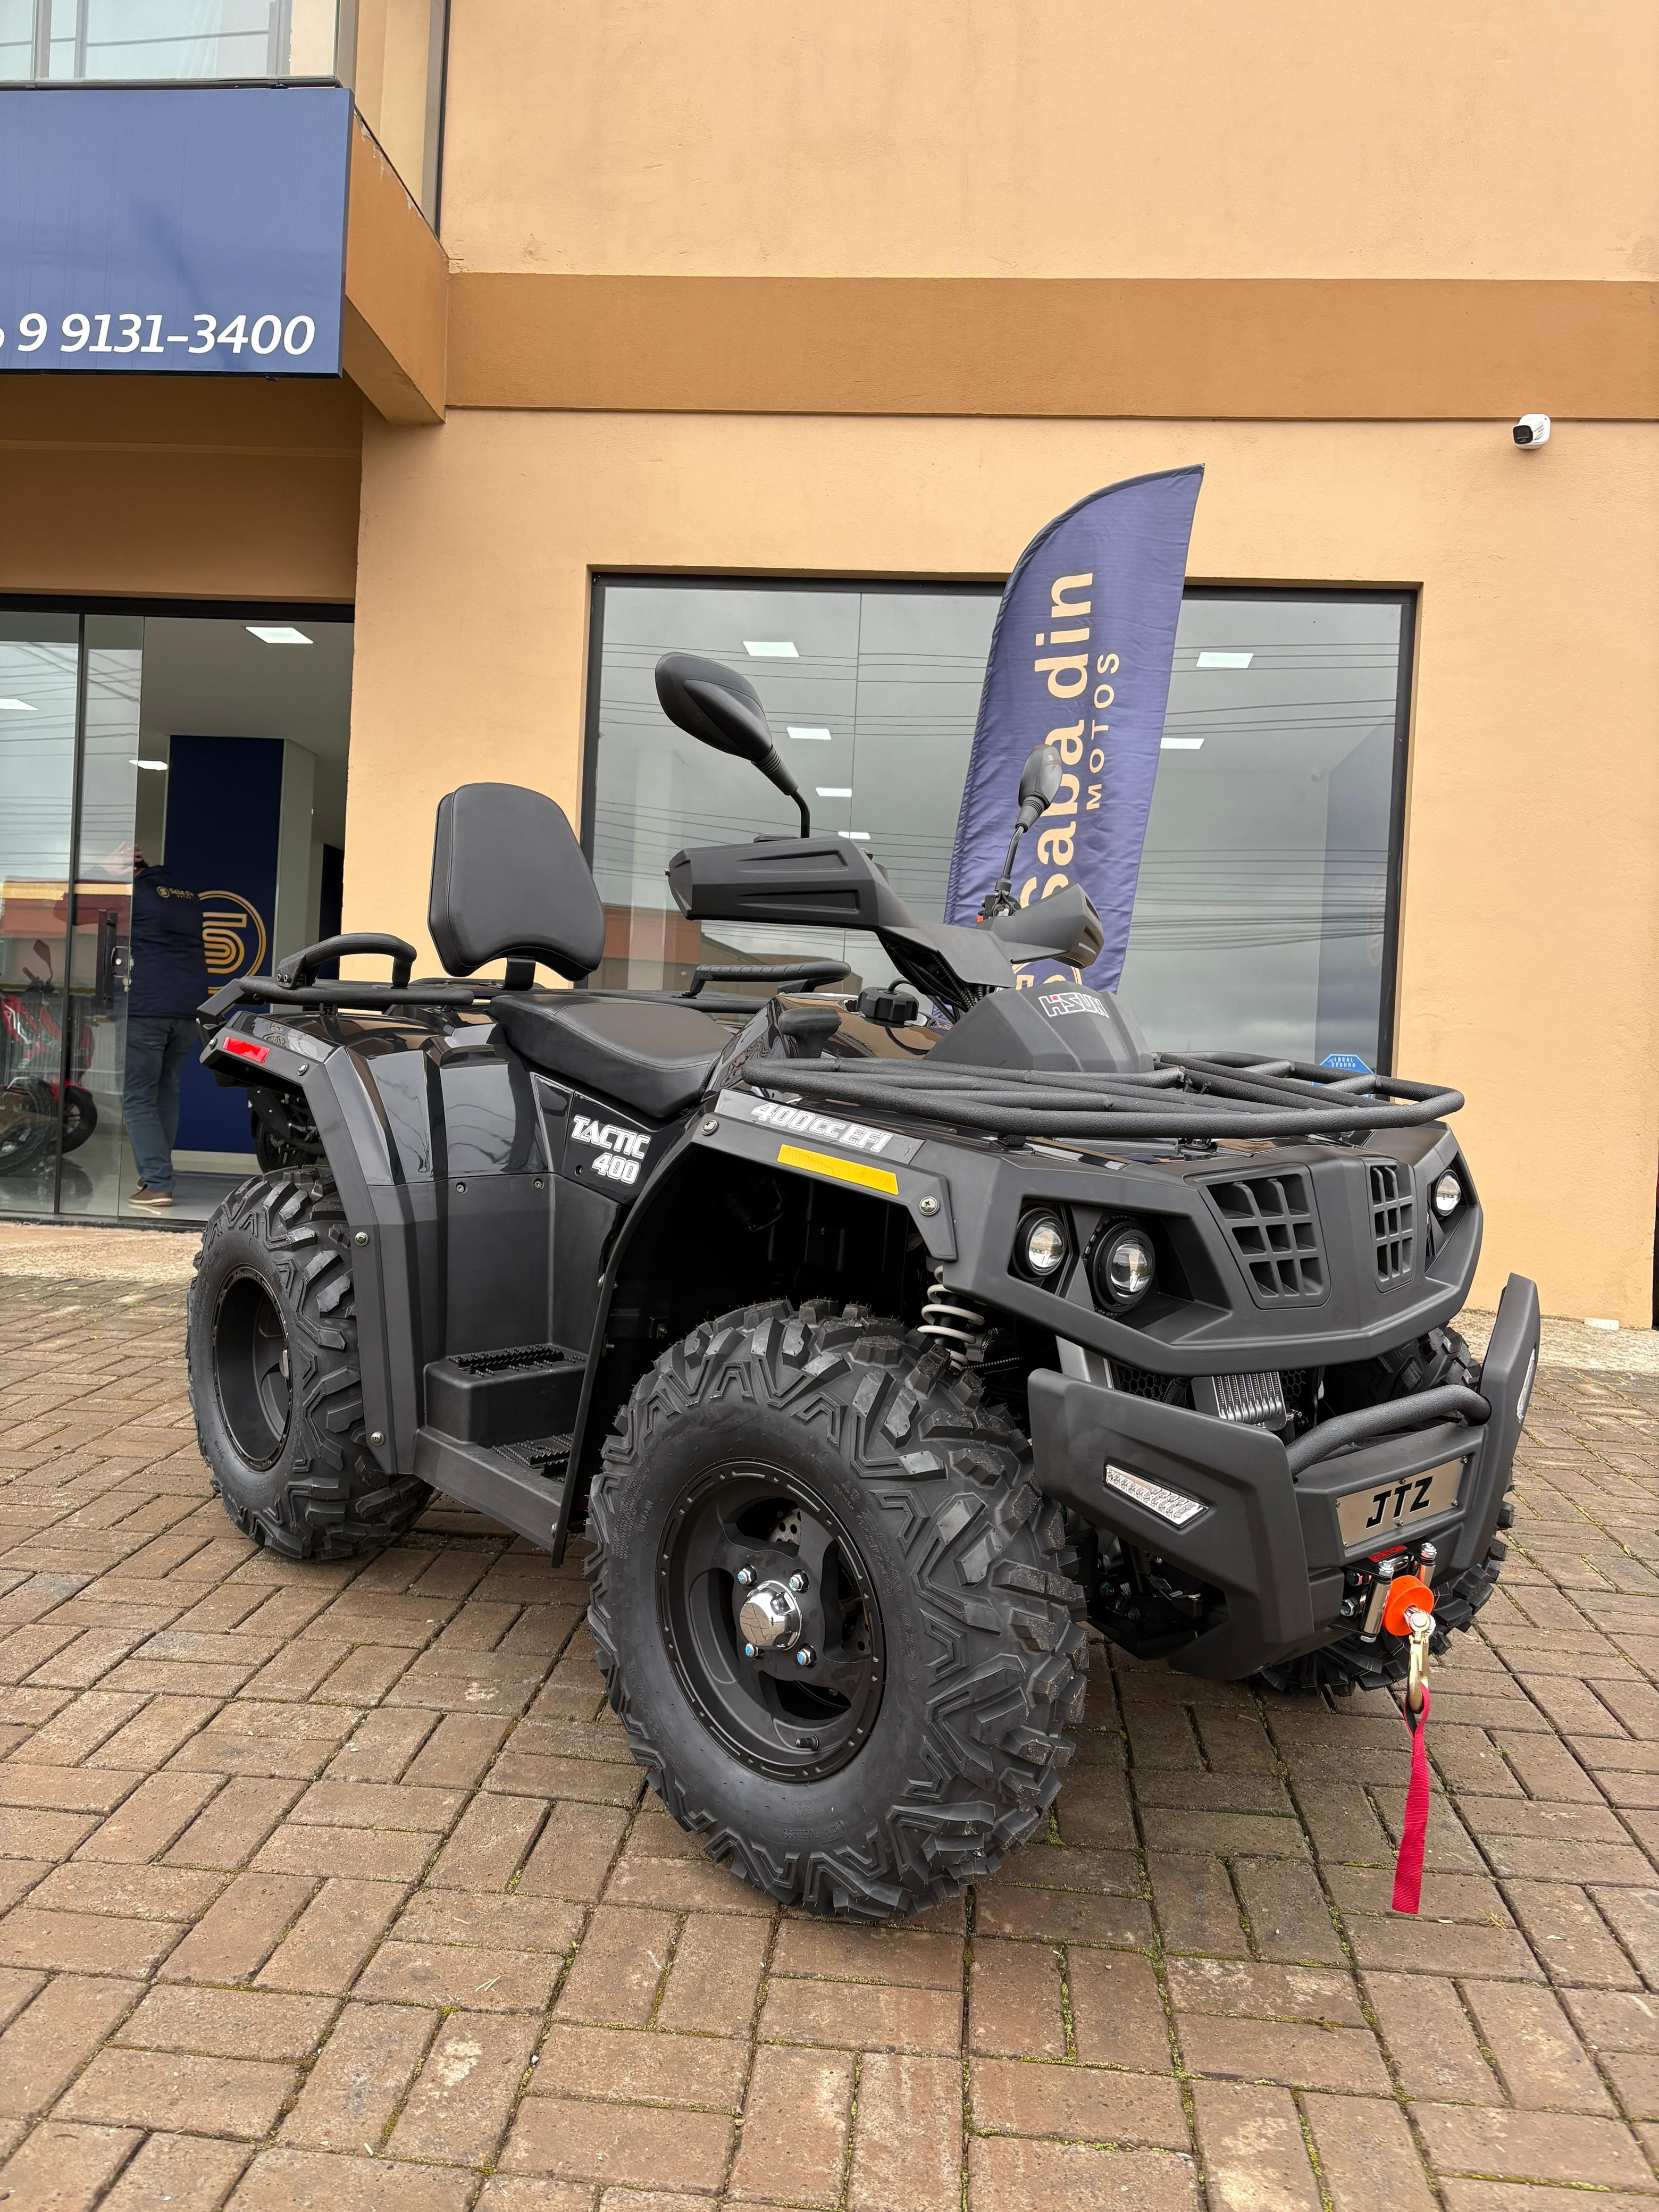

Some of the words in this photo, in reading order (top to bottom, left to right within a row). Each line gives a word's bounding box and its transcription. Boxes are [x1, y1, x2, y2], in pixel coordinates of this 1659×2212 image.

[17, 313, 47, 352] 9
[60, 313, 315, 356] 9131-3400
[1086, 653, 1120, 810] MOTOS
[571, 1115, 651, 1160] TACTIC
[839, 1123, 894, 1153] EFI
[592, 1152, 640, 1185] 400
[1365, 1475, 1434, 1530] JTZ
